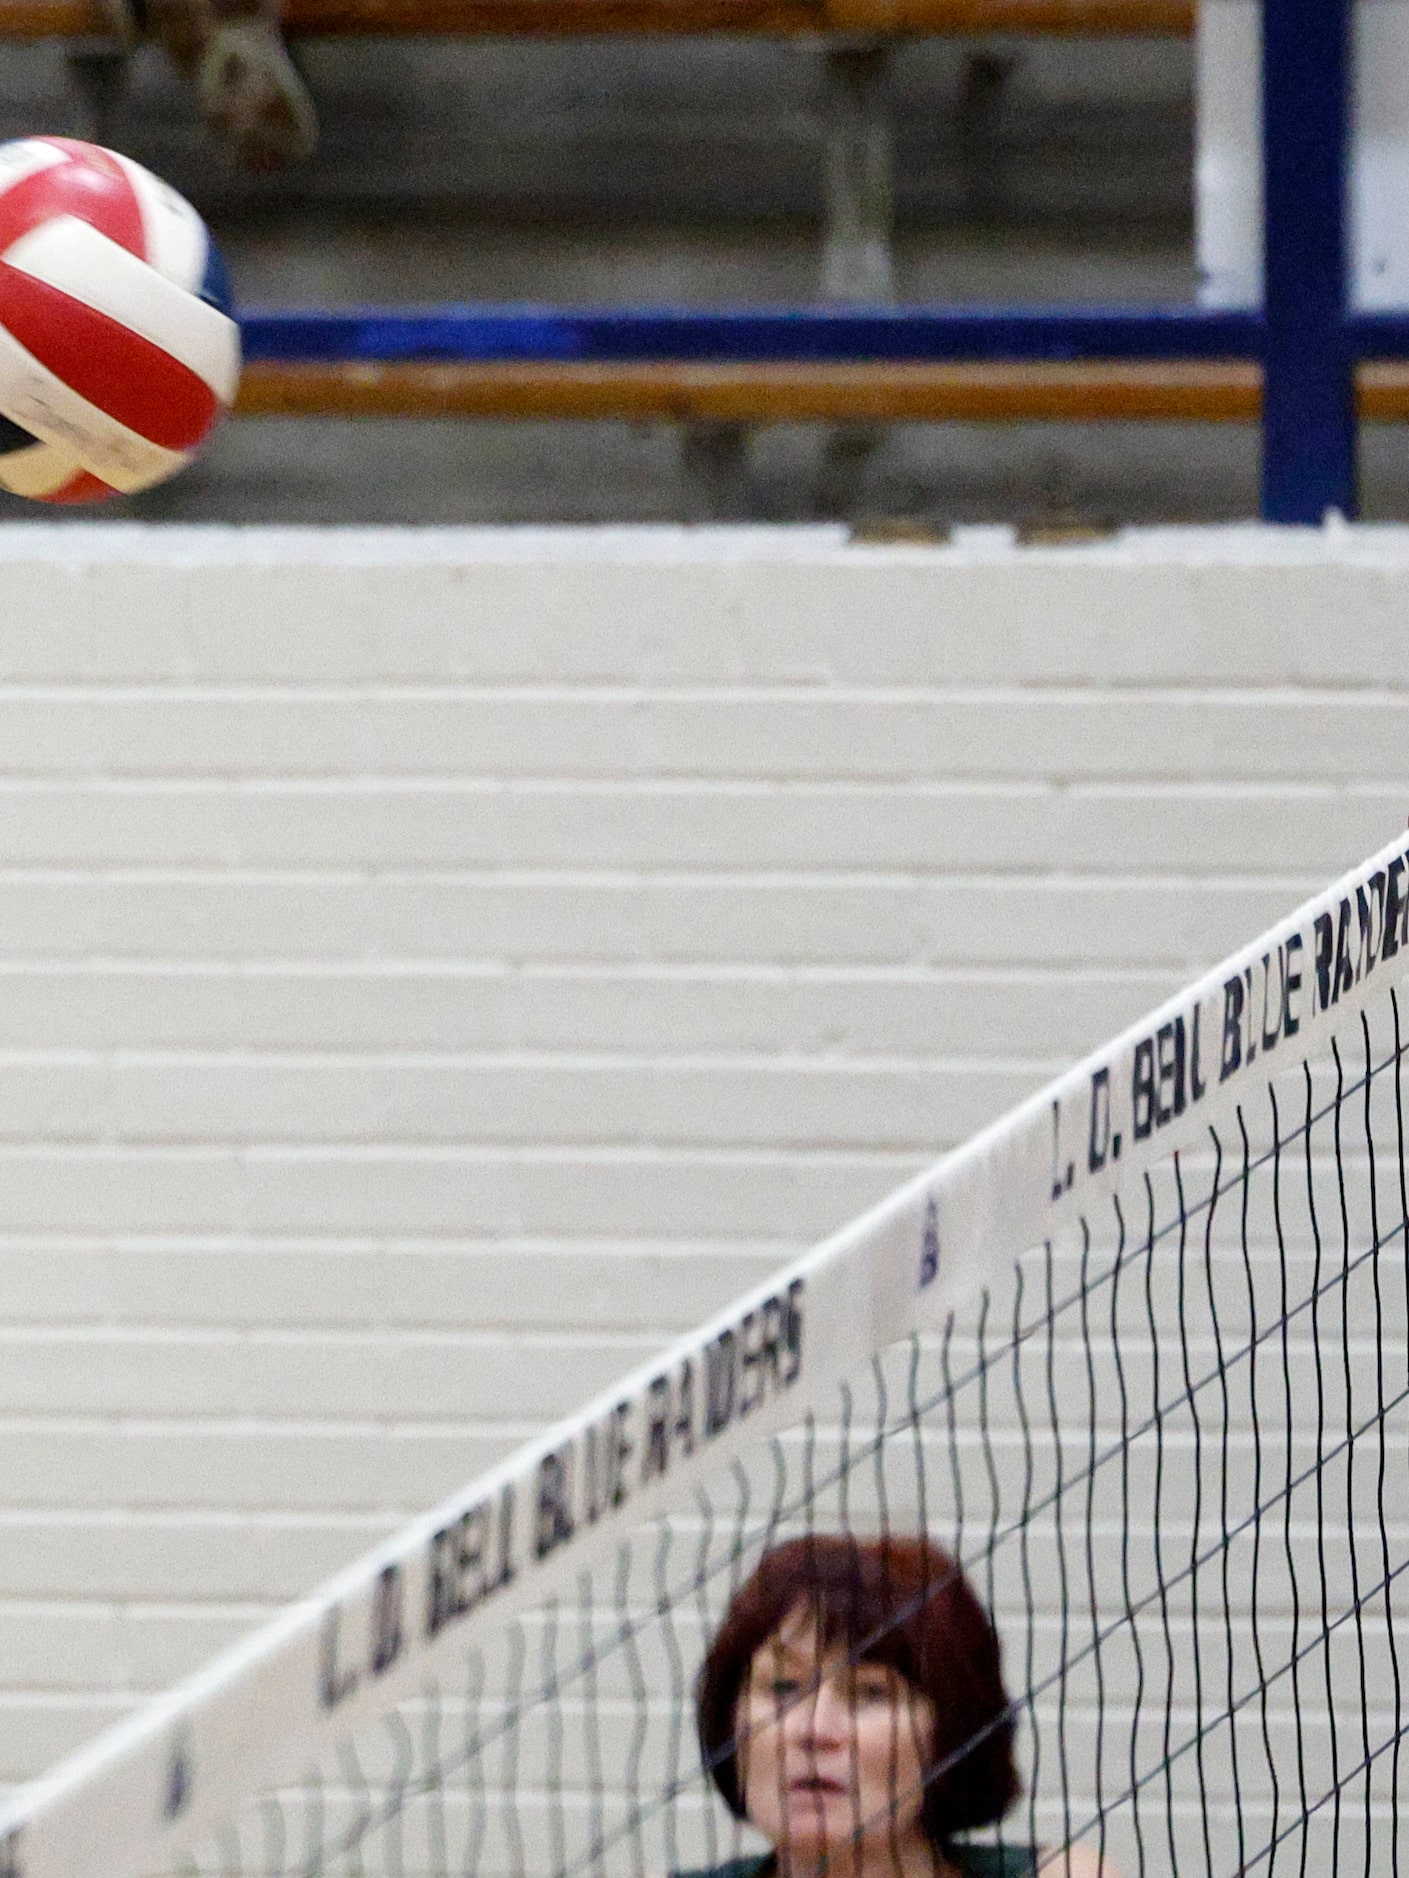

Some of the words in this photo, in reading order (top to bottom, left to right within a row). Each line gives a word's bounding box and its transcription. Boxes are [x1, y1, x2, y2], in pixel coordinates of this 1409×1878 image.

[1086, 1065, 1122, 1174] D.
[1132, 1001, 1206, 1142] BELL
[1218, 935, 1304, 1086] BLUE
[641, 1277, 805, 1484] RAIDERS
